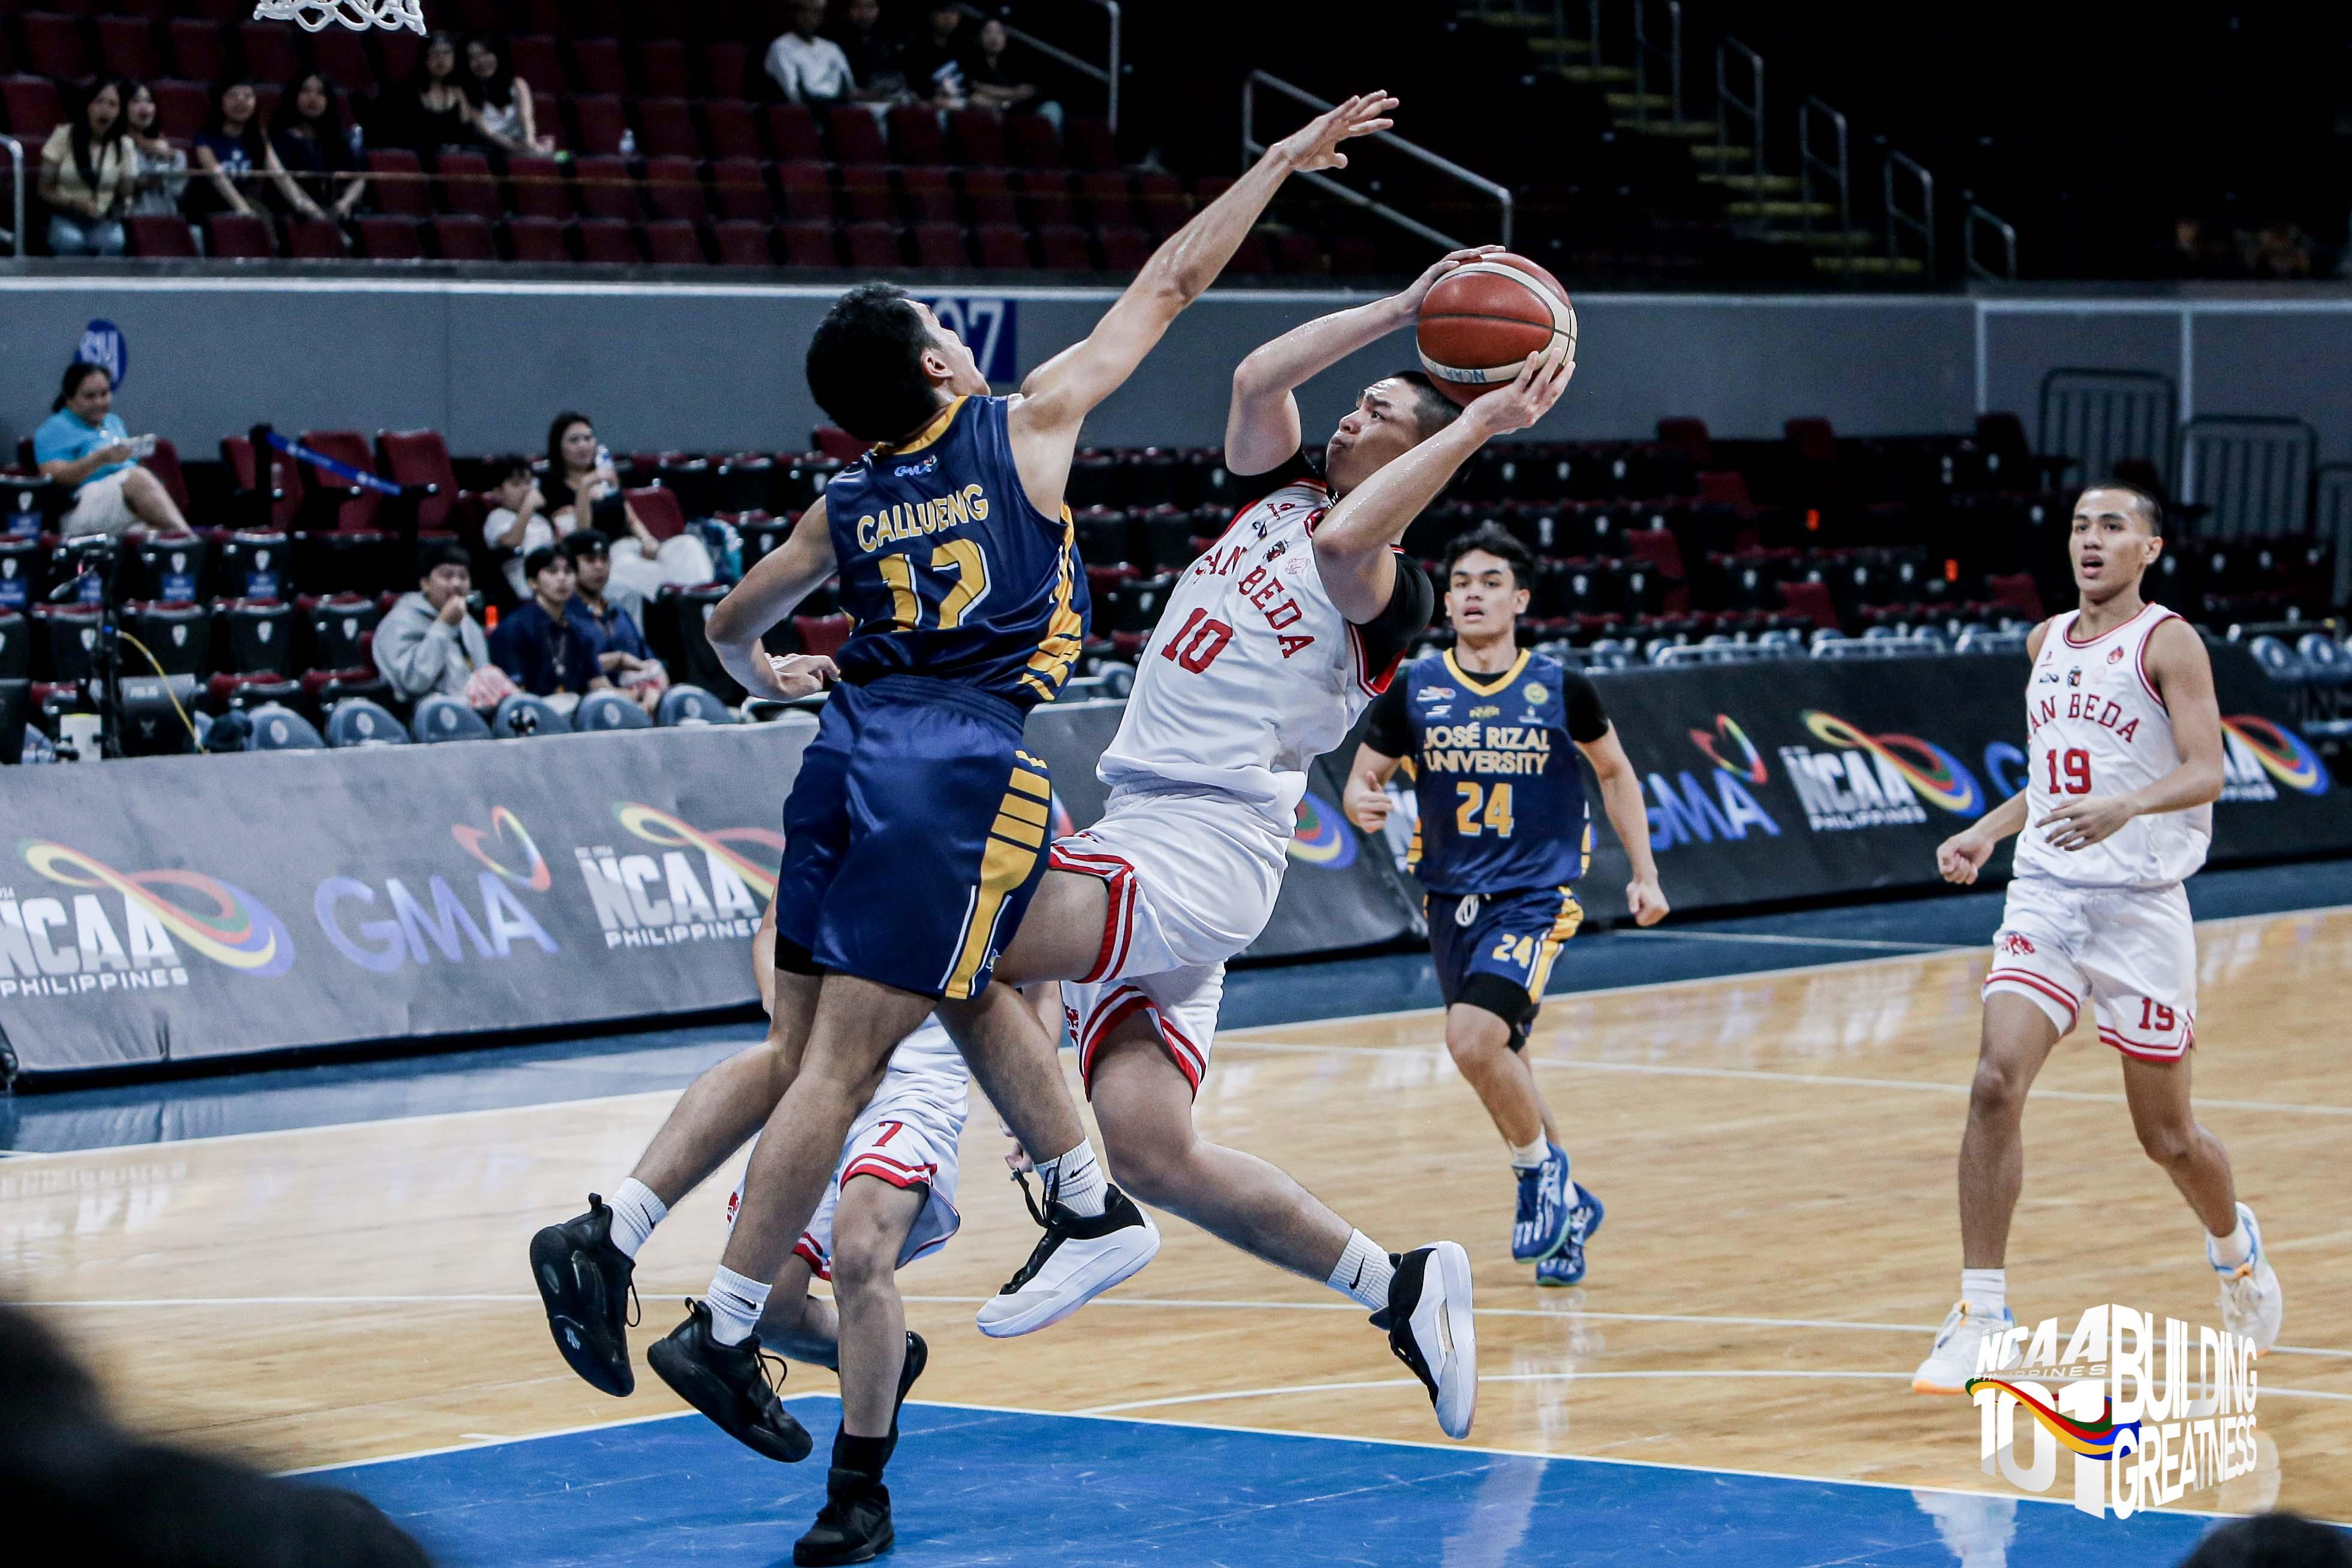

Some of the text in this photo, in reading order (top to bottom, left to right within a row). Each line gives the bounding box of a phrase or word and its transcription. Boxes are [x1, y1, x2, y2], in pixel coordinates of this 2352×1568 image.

[857, 484, 988, 547] CALLUENG
[1238, 565, 1315, 659] BEDA
[1161, 607, 1233, 674] 10
[1423, 721, 1551, 752] JOSÉ RIZAL
[2027, 693, 2139, 743] AN BEDA
[1424, 749, 1551, 775] UNIVERSITY
[1781, 750, 1919, 814] NCAA
[2047, 748, 2092, 794] 19
[1456, 782, 1514, 838] 24
[579, 852, 760, 931] NCAA
[314, 873, 561, 972] GMA
[1492, 933, 1534, 969] 24
[1, 967, 189, 998] PHILIPPINES
[2139, 997, 2175, 1032] 19
[872, 1121, 903, 1147] 7
